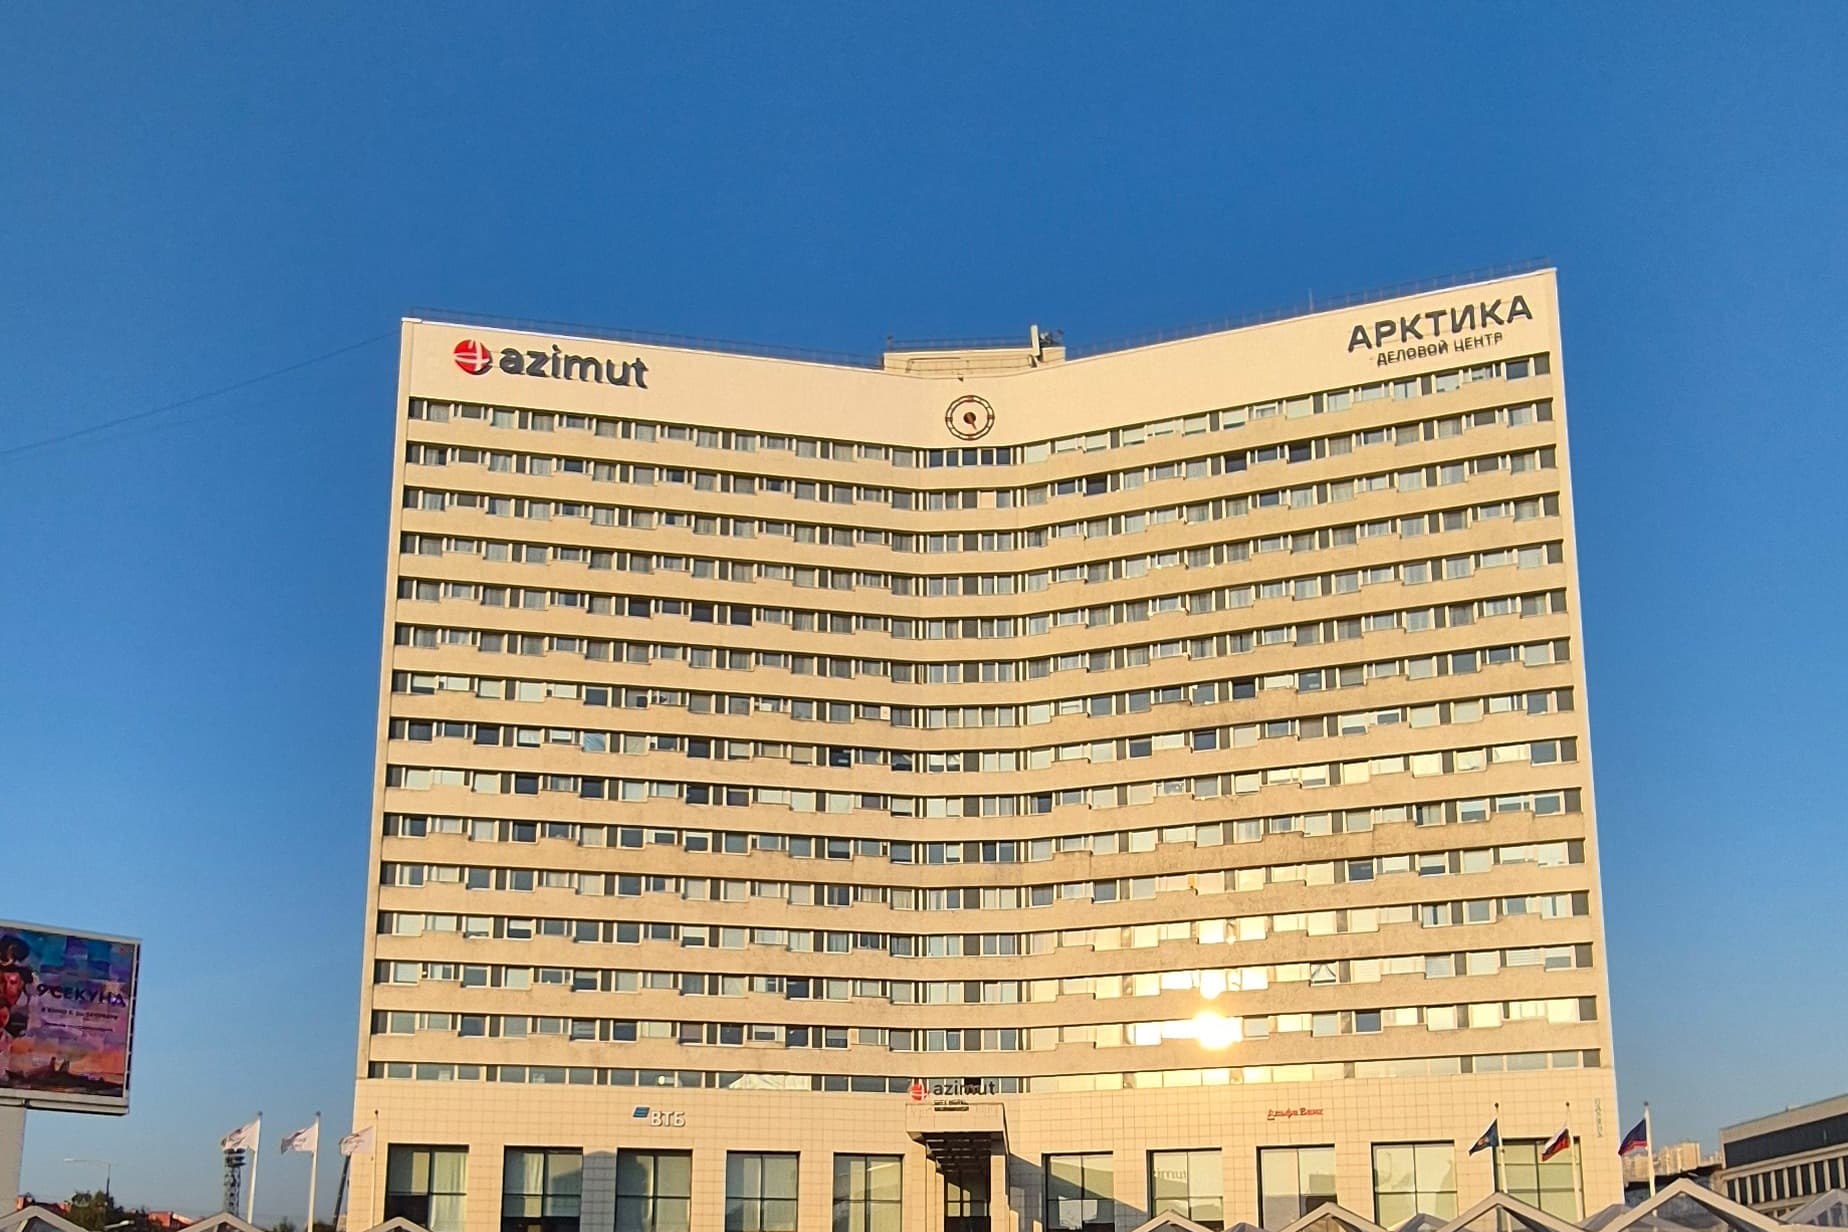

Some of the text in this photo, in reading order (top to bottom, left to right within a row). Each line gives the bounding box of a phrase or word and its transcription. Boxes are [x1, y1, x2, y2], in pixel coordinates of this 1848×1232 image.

[1348, 295, 1533, 353] АРКТИКА
[499, 343, 649, 390] azimut
[1376, 332, 1503, 367] ДЕЛОВОЙ ЦЕНТР
[933, 1079, 996, 1096] azimut
[650, 1111, 686, 1127] ВТБ
